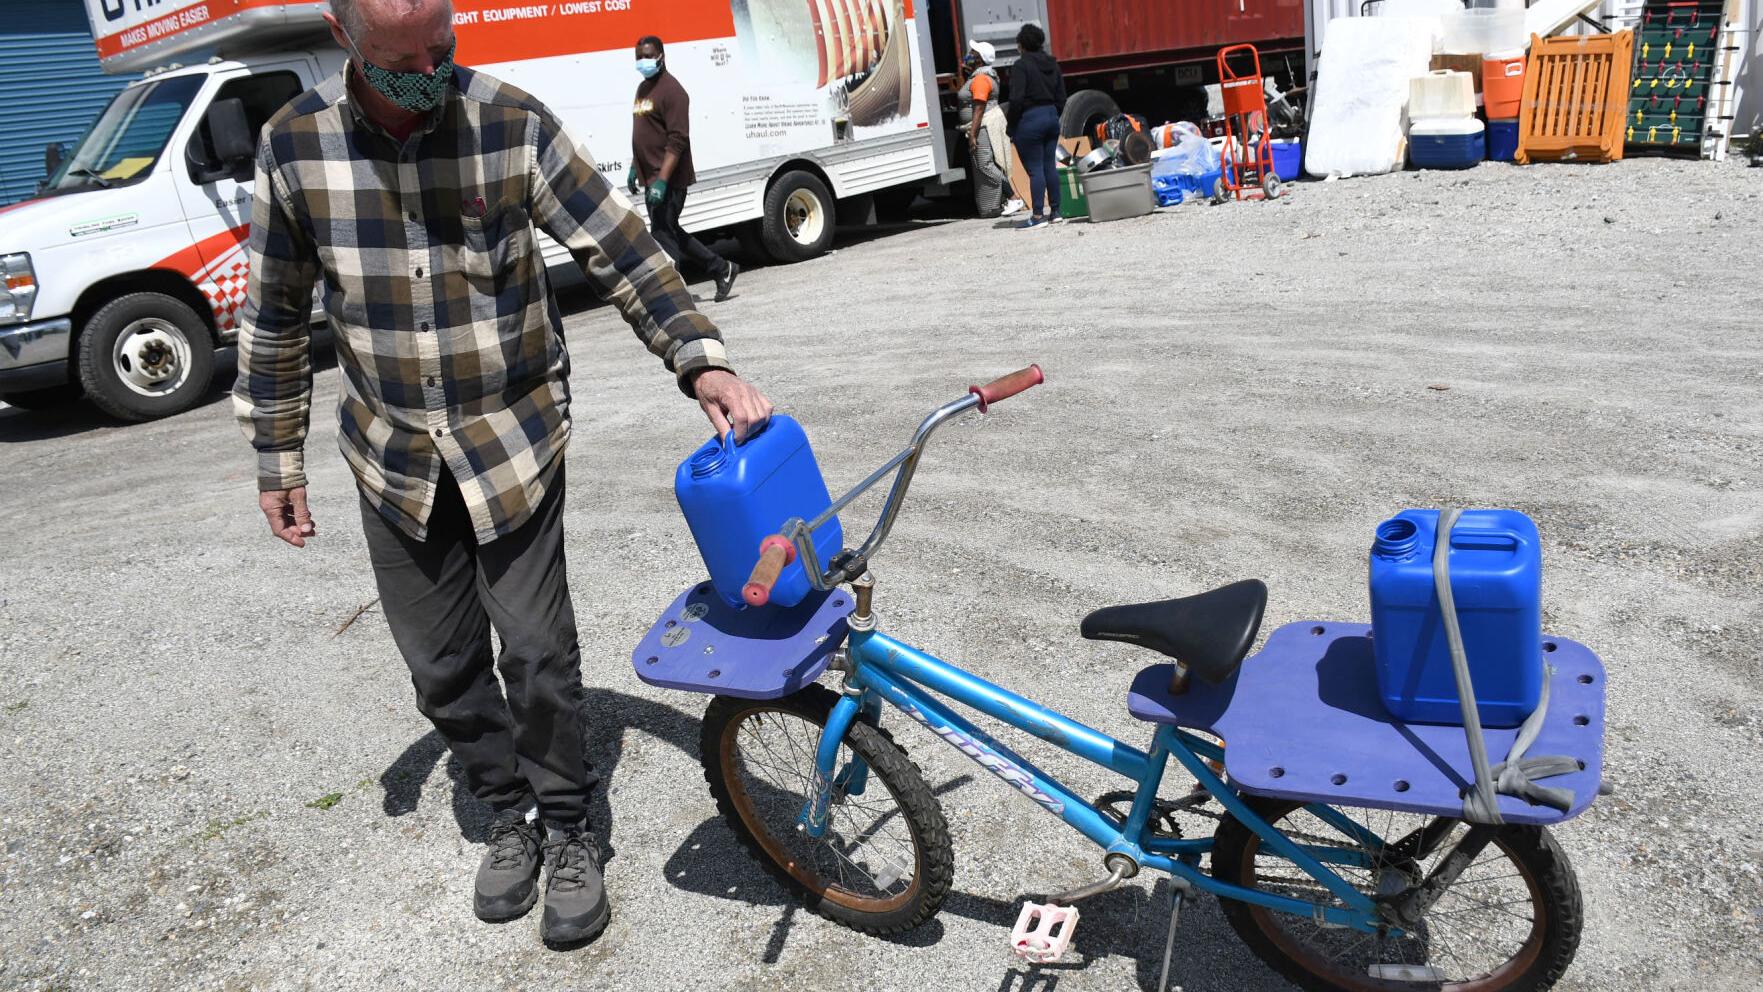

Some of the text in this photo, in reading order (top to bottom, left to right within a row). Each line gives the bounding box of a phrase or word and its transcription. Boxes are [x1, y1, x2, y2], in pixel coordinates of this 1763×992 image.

[451, 11, 479, 25] IGHT
[483, 5, 549, 22] EQUIPMENT
[559, 1, 601, 16] LOWEST
[604, 0, 632, 12] COST
[120, 27, 148, 48] MAKES
[146, 15, 181, 39] MOVING
[179, 5, 210, 28] EASIER
[745, 130, 787, 139] uhaul.com
